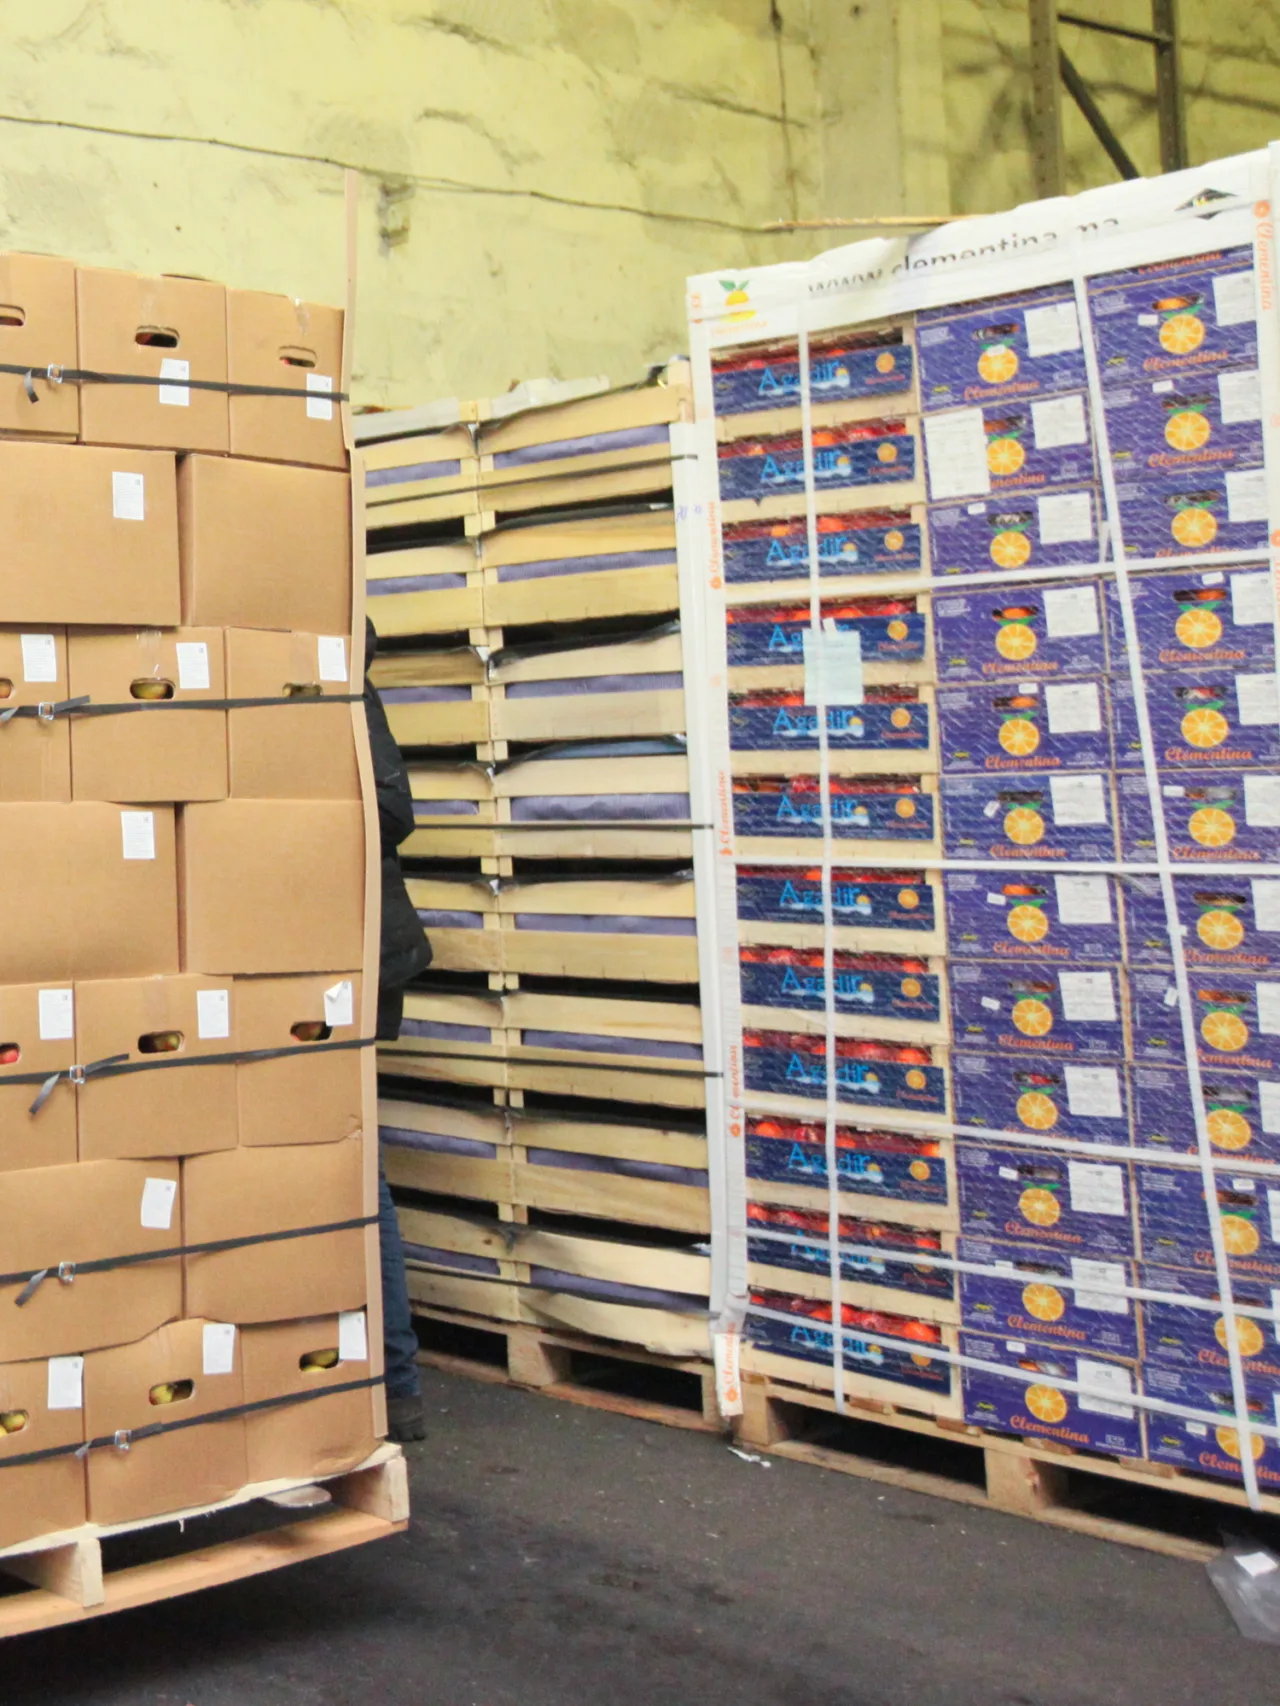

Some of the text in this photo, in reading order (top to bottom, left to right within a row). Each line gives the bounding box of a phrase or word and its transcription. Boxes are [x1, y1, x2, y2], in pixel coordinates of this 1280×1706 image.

[1143, 350, 1228, 371] Clementina
[758, 361, 840, 394] Agadir
[761, 450, 841, 482] Agadir
[1148, 449, 1235, 468] Clementina
[766, 535, 848, 565] Agadir
[1158, 648, 1247, 663] Clementina
[982, 661, 1059, 674] Clementina
[773, 708, 855, 737] Agadir
[985, 756, 1062, 769] Clementina
[1164, 747, 1253, 762] Clementina
[776, 795, 858, 823] Agadir
[990, 845, 1067, 858] Clementina
[1173, 847, 1261, 860] Clementina
[779, 879, 860, 908] Agadir
[993, 942, 1070, 956] Clementina
[781, 966, 863, 995] Agadir
[998, 1034, 1074, 1050] Clementina
[786, 1053, 869, 1084] Agadir
[1197, 1048, 1272, 1068] lementina
[788, 1143, 871, 1175] Agadir
[1004, 1221, 1084, 1244] Clementina
[1007, 1315, 1087, 1341] Clementina
[1010, 1415, 1090, 1443] Clementina
